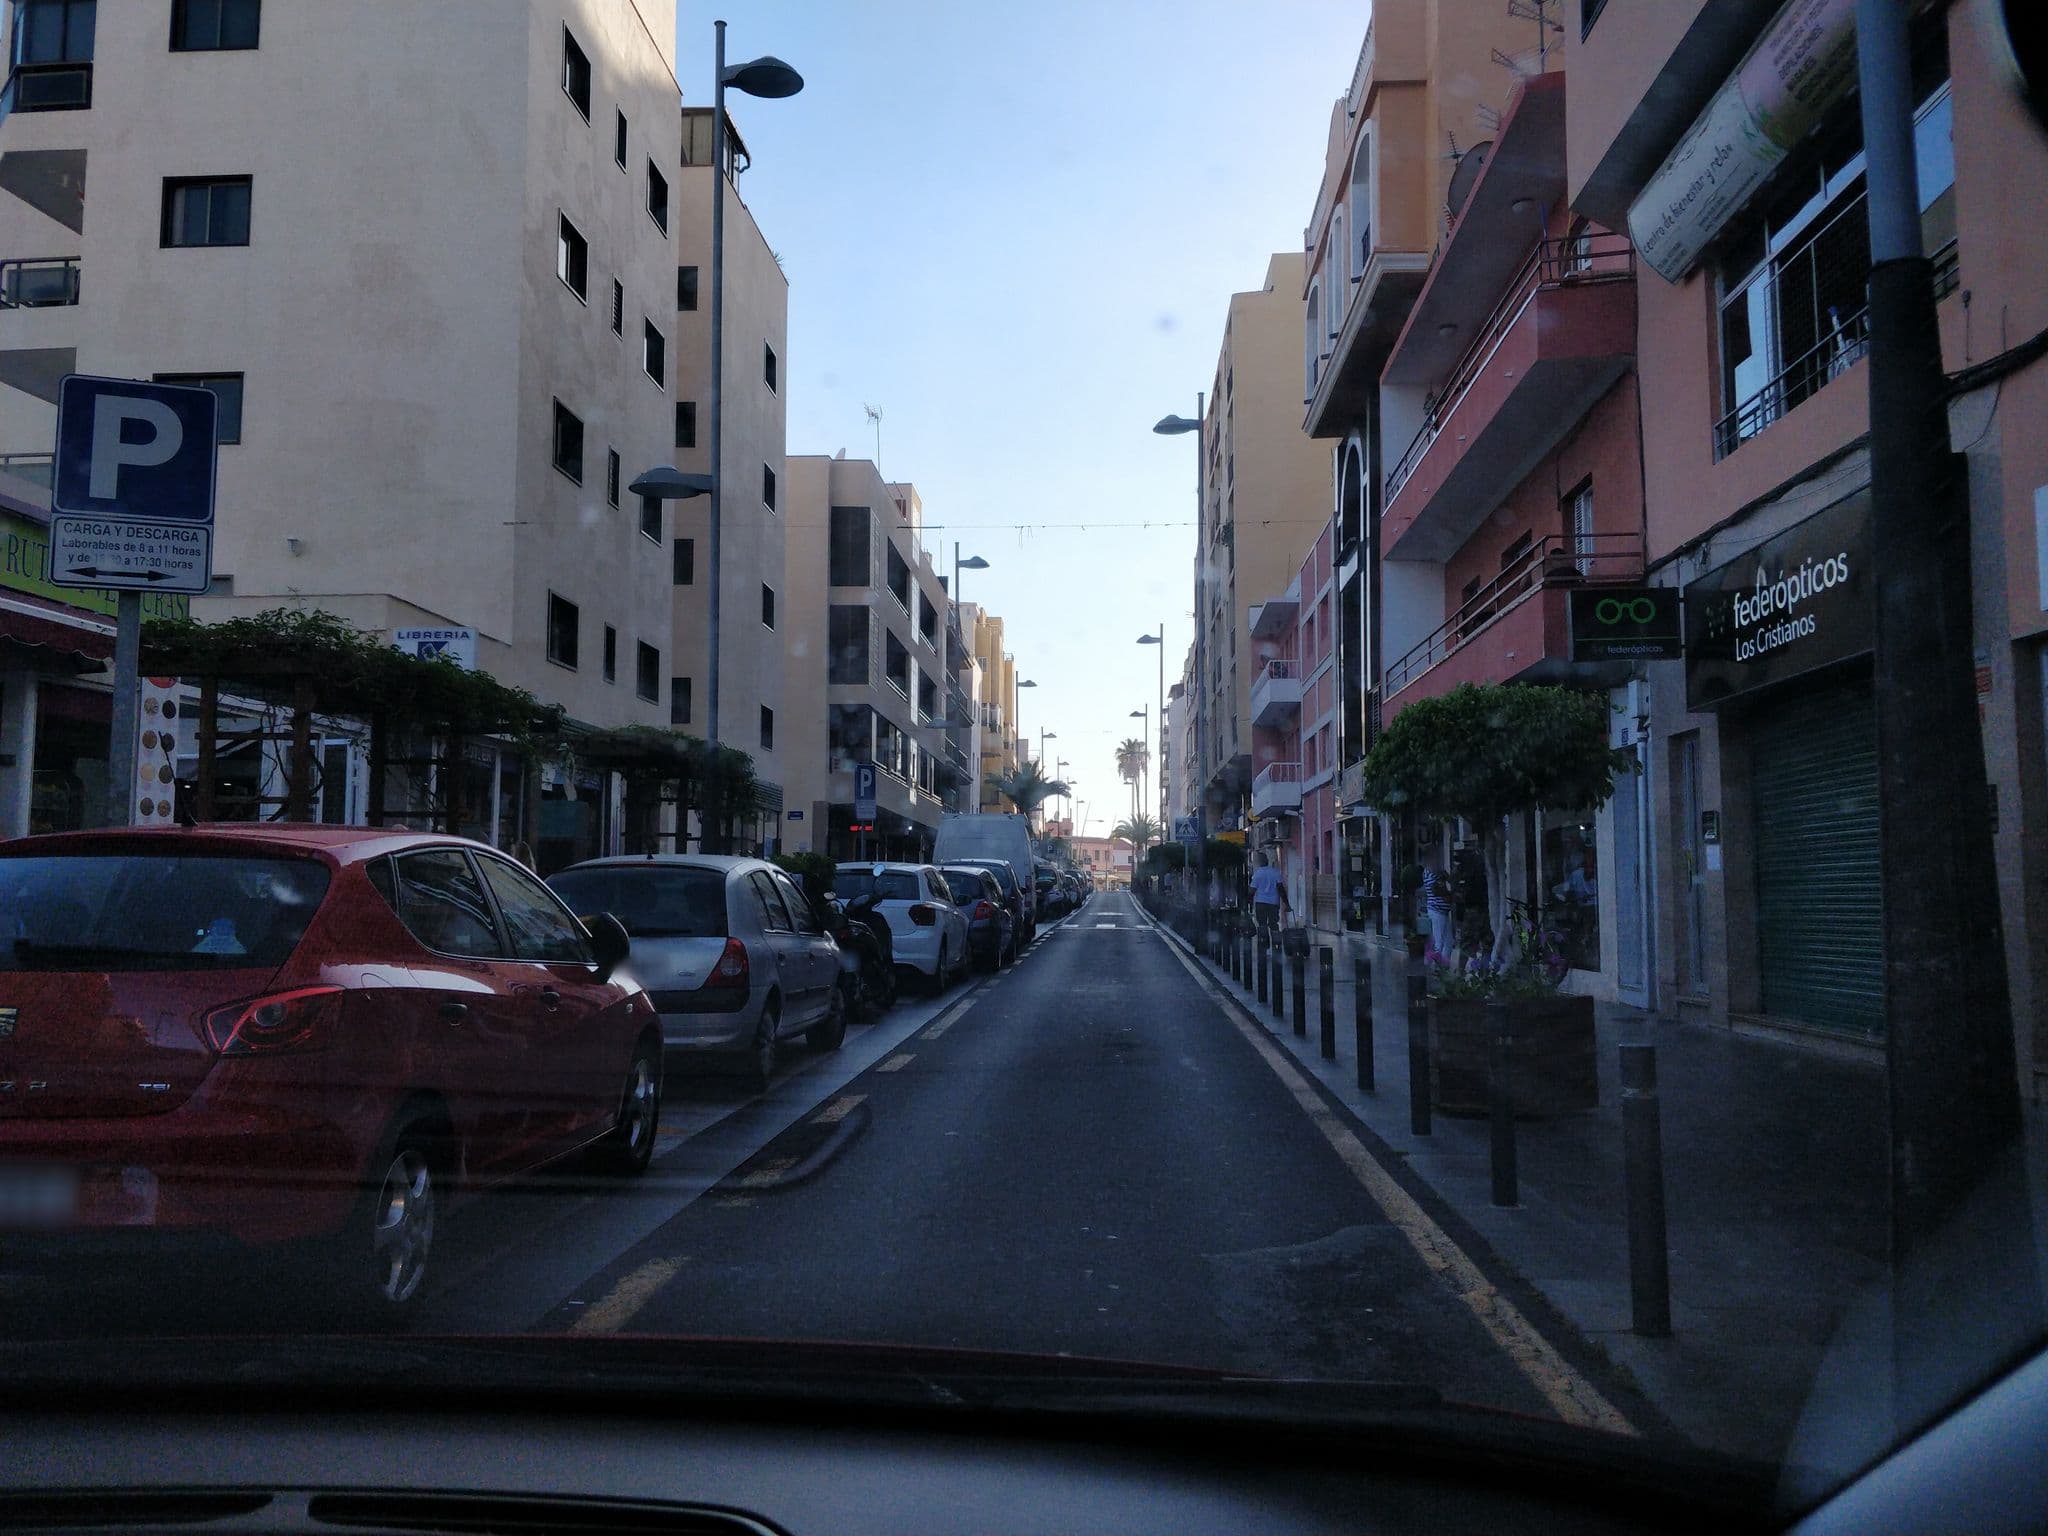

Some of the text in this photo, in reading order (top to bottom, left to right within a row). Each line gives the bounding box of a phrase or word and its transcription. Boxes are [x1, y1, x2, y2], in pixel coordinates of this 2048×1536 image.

[1661, 210, 1676, 231] de
[1669, 175, 1707, 219] bienestar
[89, 393, 184, 500] P
[63, 521, 200, 543] CARGA Y DESCARGA
[62, 538, 202, 557] Laborables de 8 a 11 horas
[68, 554, 75, 564] y
[77, 552, 90, 563] de
[123, 557, 131, 566] a
[134, 556, 162, 568] 17:30
[165, 558, 194, 570] horas
[1733, 551, 1849, 628] federópticos
[397, 631, 470, 639] LIBRERIA
[1735, 613, 1818, 662] Los Cristianos
[860, 768, 873, 797] P
